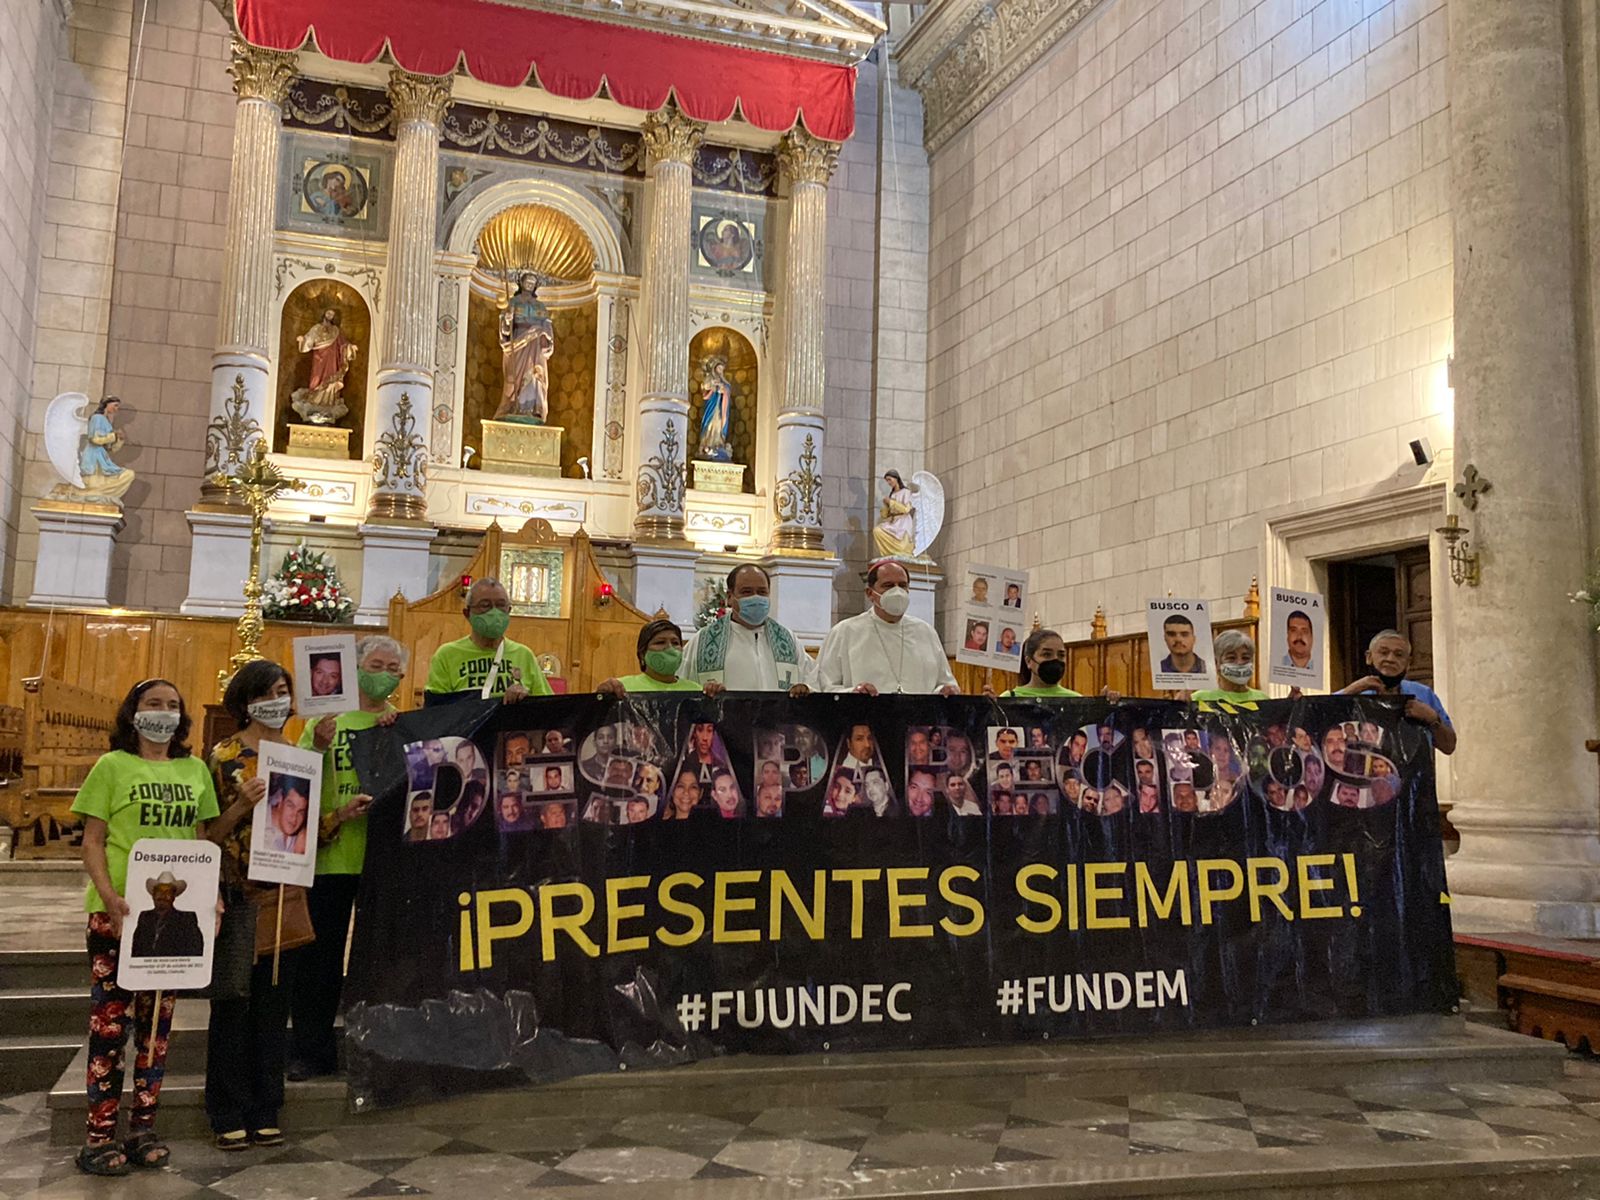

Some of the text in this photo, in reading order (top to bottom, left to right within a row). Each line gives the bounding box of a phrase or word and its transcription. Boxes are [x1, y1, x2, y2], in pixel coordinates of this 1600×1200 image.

[1150, 602, 1204, 611] BUSCO A
[1276, 593, 1319, 608] BUSCO A
[267, 755, 317, 776] Desaparecido
[402, 720, 1403, 841] DESAPARECIDOS
[134, 851, 212, 864] Desaparecido
[458, 853, 1363, 972] ¡PRESENTES SIEMPRE!
[676, 969, 1189, 1032] #FUUNDEC #FUNDEM
